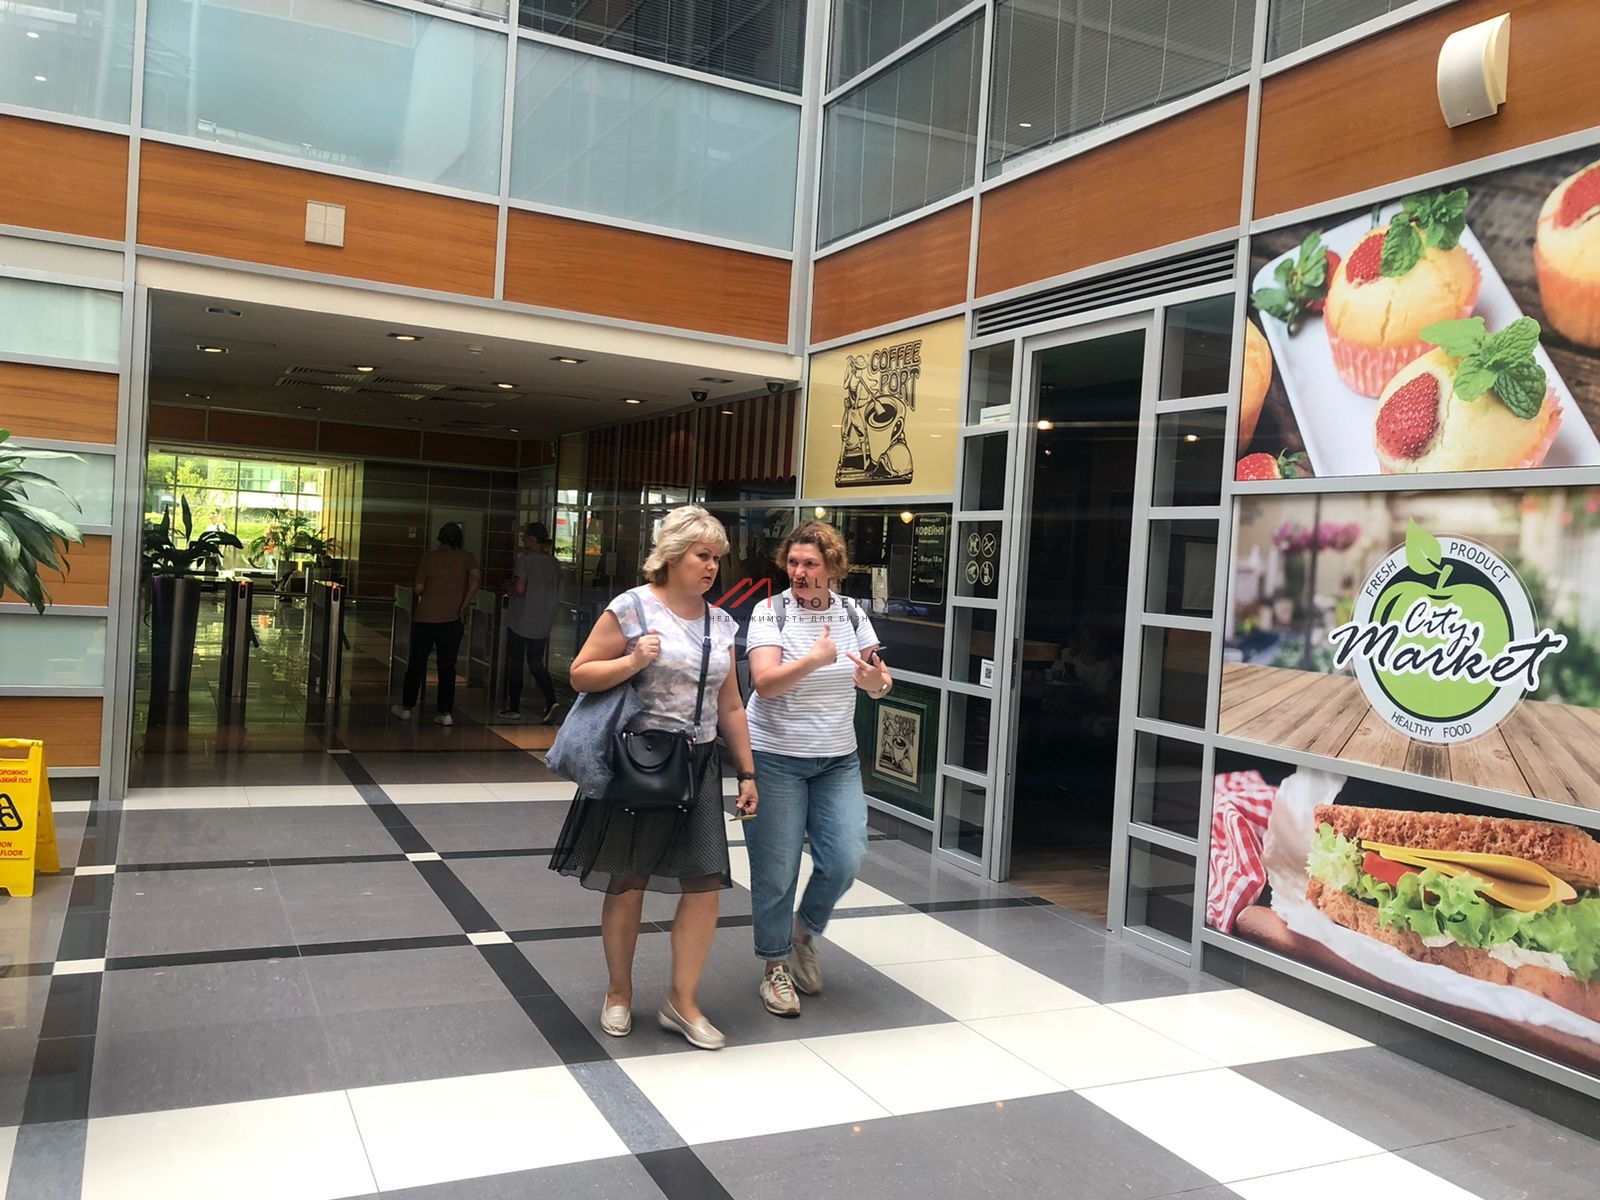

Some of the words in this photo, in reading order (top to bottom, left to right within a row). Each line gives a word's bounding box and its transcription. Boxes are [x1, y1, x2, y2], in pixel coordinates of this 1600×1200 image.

[870, 339, 923, 374] COFFEE
[879, 366, 921, 412] PORT
[915, 525, 945, 536] КОФЕЙНЯ
[1365, 559, 1398, 598] FRESH
[1449, 541, 1511, 583] PRODUCT
[1405, 601, 1469, 655] City
[1331, 626, 1563, 686] Market
[1390, 711, 1434, 738] HEALTHY
[1443, 723, 1472, 738] FOOD
